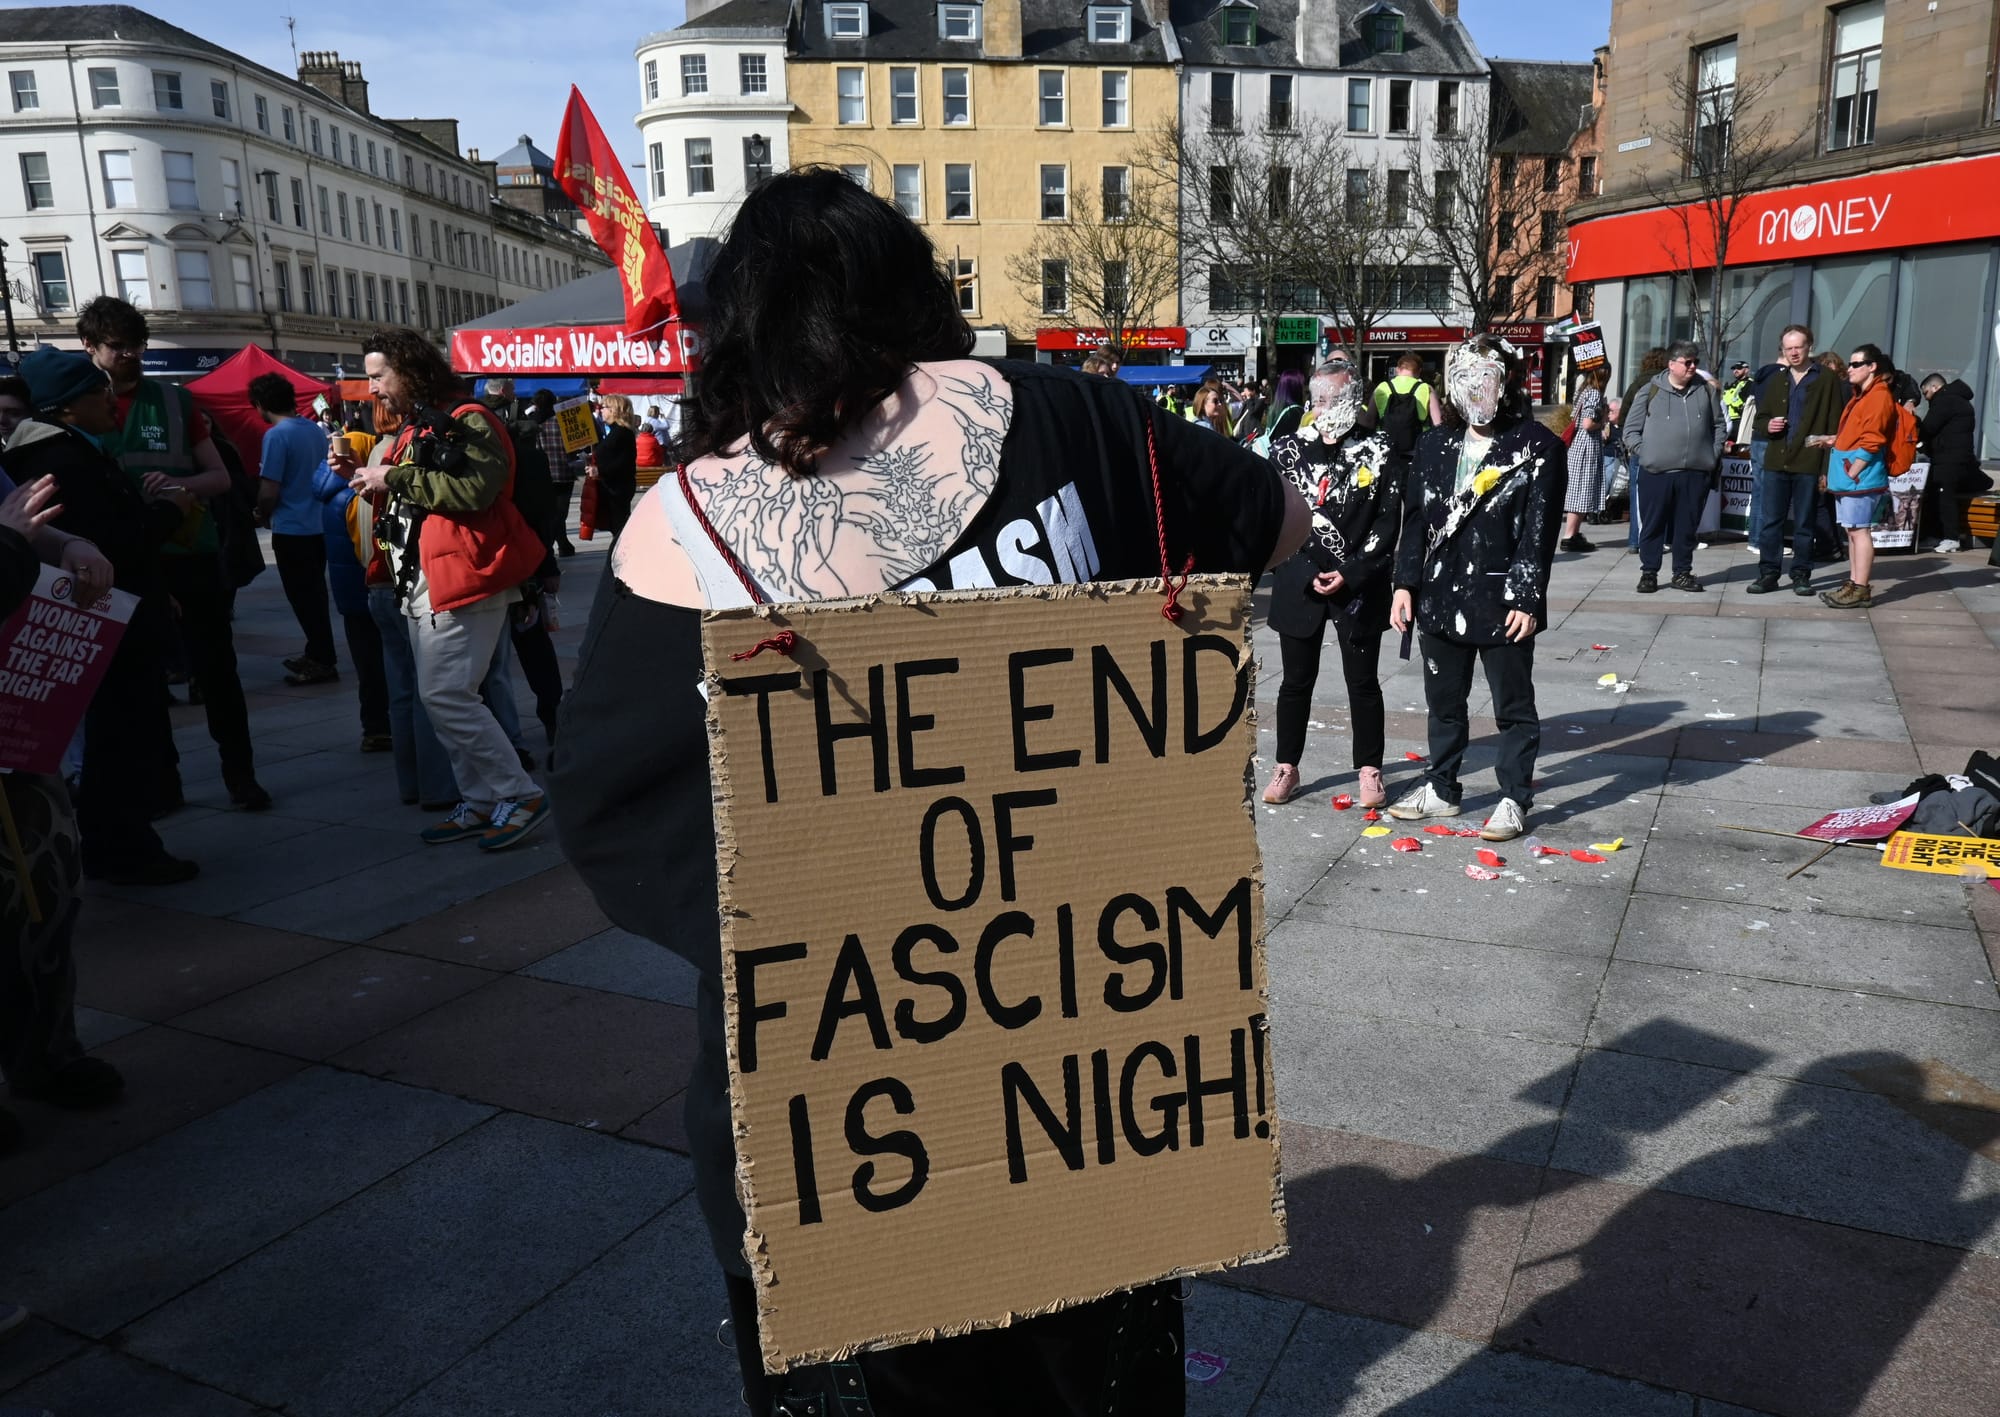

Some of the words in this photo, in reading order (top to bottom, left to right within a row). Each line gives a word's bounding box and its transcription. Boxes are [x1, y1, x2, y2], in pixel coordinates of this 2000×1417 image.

[1208, 329, 1229, 341] CK
[1369, 332, 1407, 341] BAYNE'S
[481, 334, 563, 367] Socialist
[569, 331, 671, 367] Workers
[1575, 347, 1605, 362] WELCOME
[195, 355, 220, 368] Boots
[560, 406, 581, 419] STOP
[563, 416, 577, 426] THE
[565, 423, 580, 434] FAR
[567, 428, 591, 442] RIGHT
[896, 480, 1100, 592] ASM
[27, 600, 103, 640] WOMEN
[12, 624, 103, 664] AGAINST
[6, 647, 49, 675] THE
[46, 658, 84, 685] FAR
[724, 657, 965, 803] THE
[1008, 635, 1249, 772] END
[919, 788, 1057, 912] OF
[1910, 838, 1938, 867] RIGHT
[1937, 840, 1962, 856] FAR
[1962, 843, 1987, 859] THE
[733, 877, 1253, 1074] FASCISM
[788, 1077, 930, 1226] IS
[1002, 1012, 1271, 1184] NIGH!
